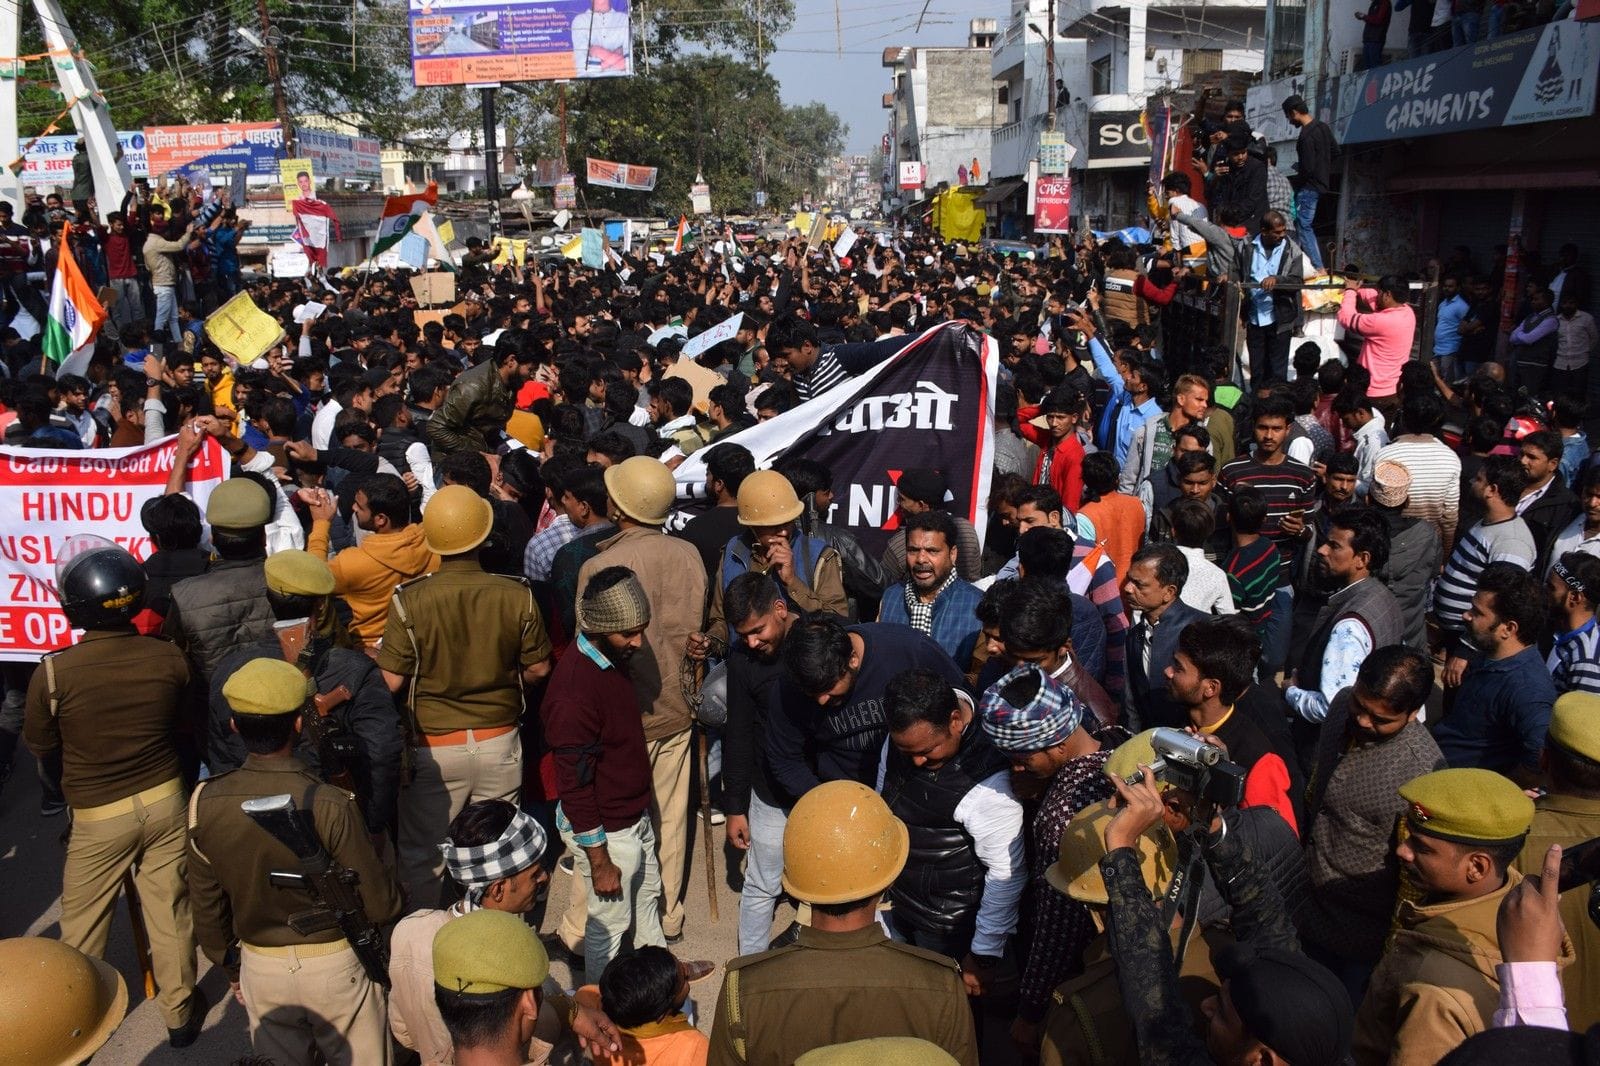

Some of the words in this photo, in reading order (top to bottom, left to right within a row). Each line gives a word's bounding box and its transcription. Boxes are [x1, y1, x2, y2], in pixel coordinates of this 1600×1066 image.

[427, 71, 453, 84] OPEN
[1380, 62, 1437, 99] APPLE
[1385, 87, 1494, 133] GARMENTS
[147, 129, 178, 153] पुलिस
[8, 455, 68, 475] Cab!
[80, 454, 152, 479] Boycott
[22, 492, 133, 522] HINDU
[1170, 870, 1184, 903] SONY
